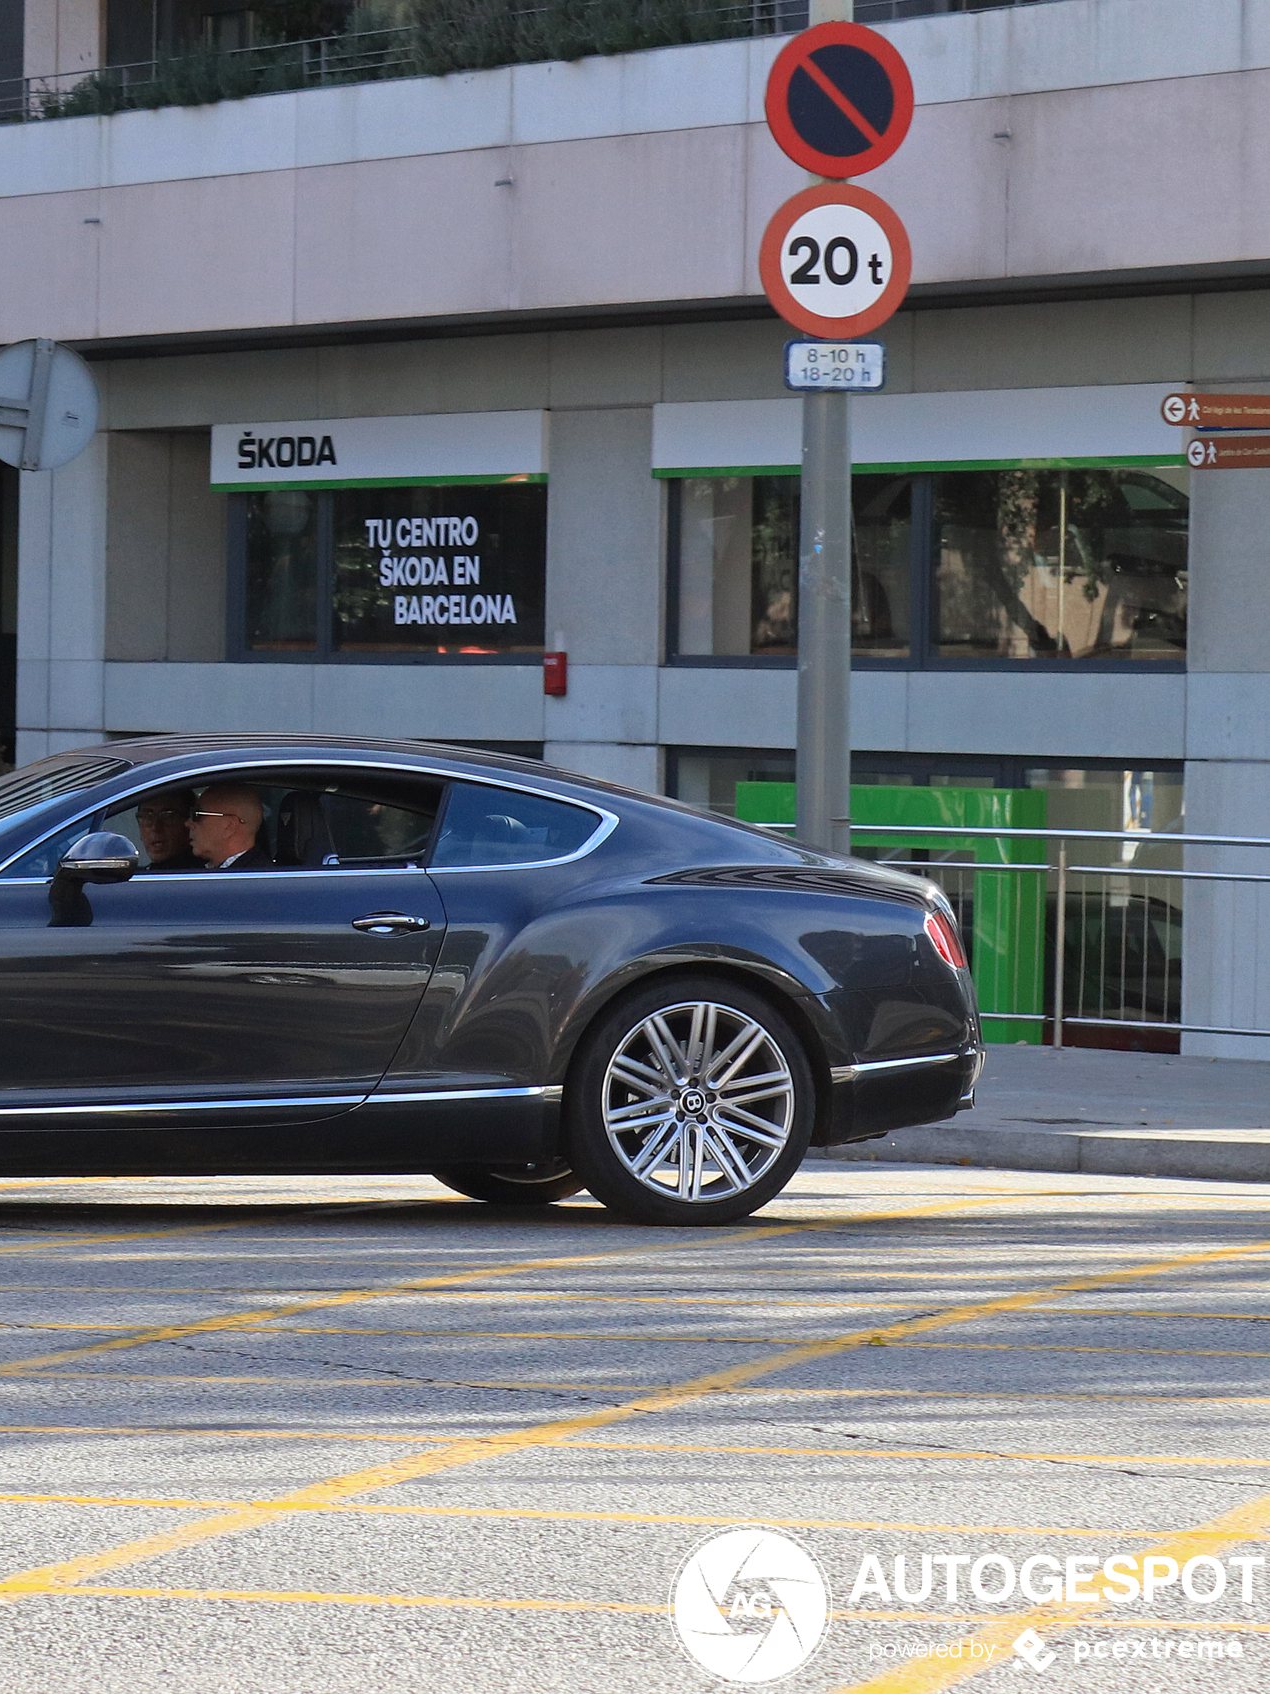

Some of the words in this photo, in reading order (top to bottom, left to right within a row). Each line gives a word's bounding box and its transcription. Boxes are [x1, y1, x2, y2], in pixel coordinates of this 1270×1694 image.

[789, 236, 858, 285] 20
[868, 253, 883, 285] t
[807, 349, 848, 363] 8-10
[855, 349, 866, 363] h
[801, 367, 854, 382] 18-20
[861, 368, 871, 382] h
[238, 432, 337, 469] ŠKODA
[365, 519, 392, 548] TU
[396, 516, 479, 547] CENTRO
[380, 550, 449, 587] ŠKODA
[453, 556, 480, 585] EN
[394, 595, 517, 625] BARCELONA
